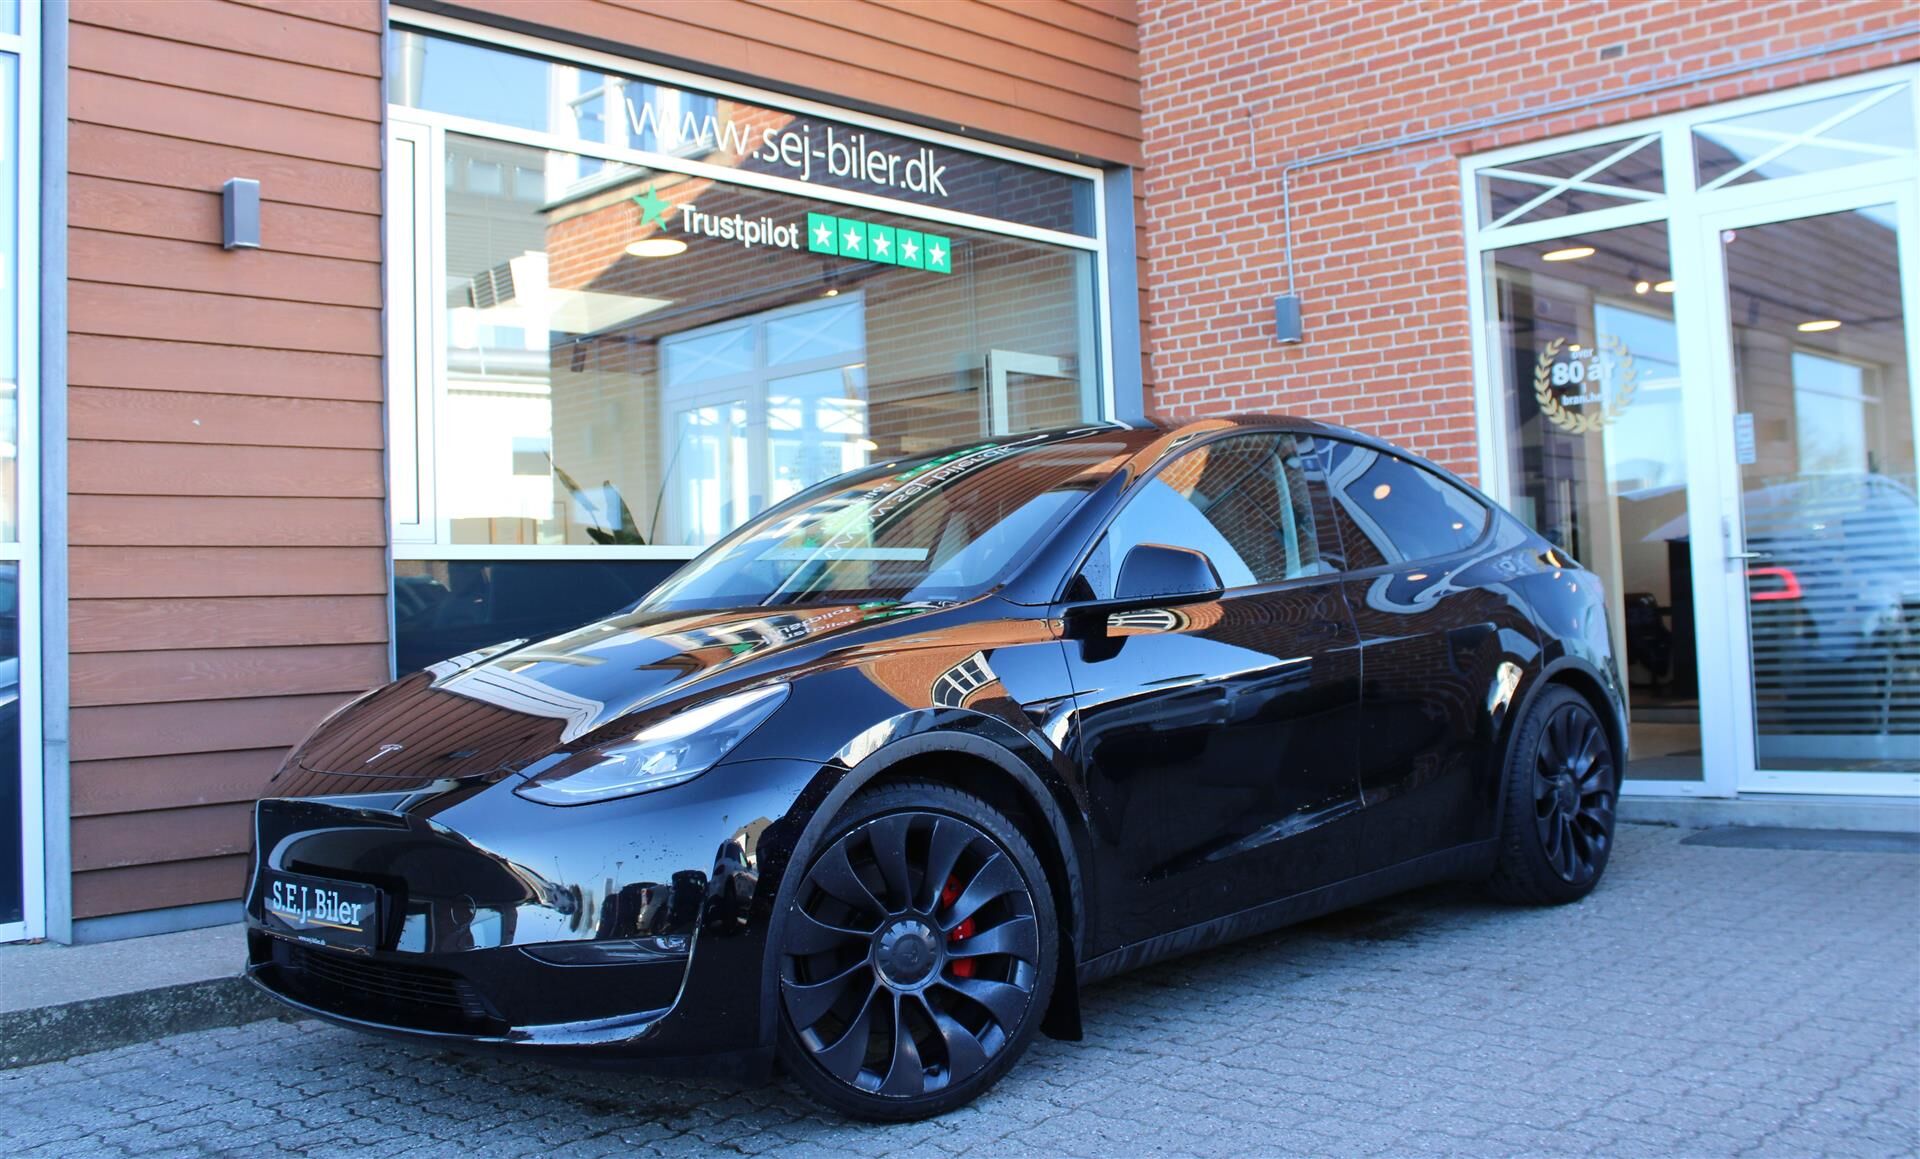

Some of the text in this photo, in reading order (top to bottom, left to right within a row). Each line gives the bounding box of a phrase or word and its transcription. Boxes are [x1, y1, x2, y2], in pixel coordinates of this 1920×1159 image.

[624, 97, 948, 197] www.sej-biler.dk
[676, 203, 799, 249] Trustpilot
[1552, 360, 1585, 386] 80
[272, 880, 361, 926] S.E.J. Biler
